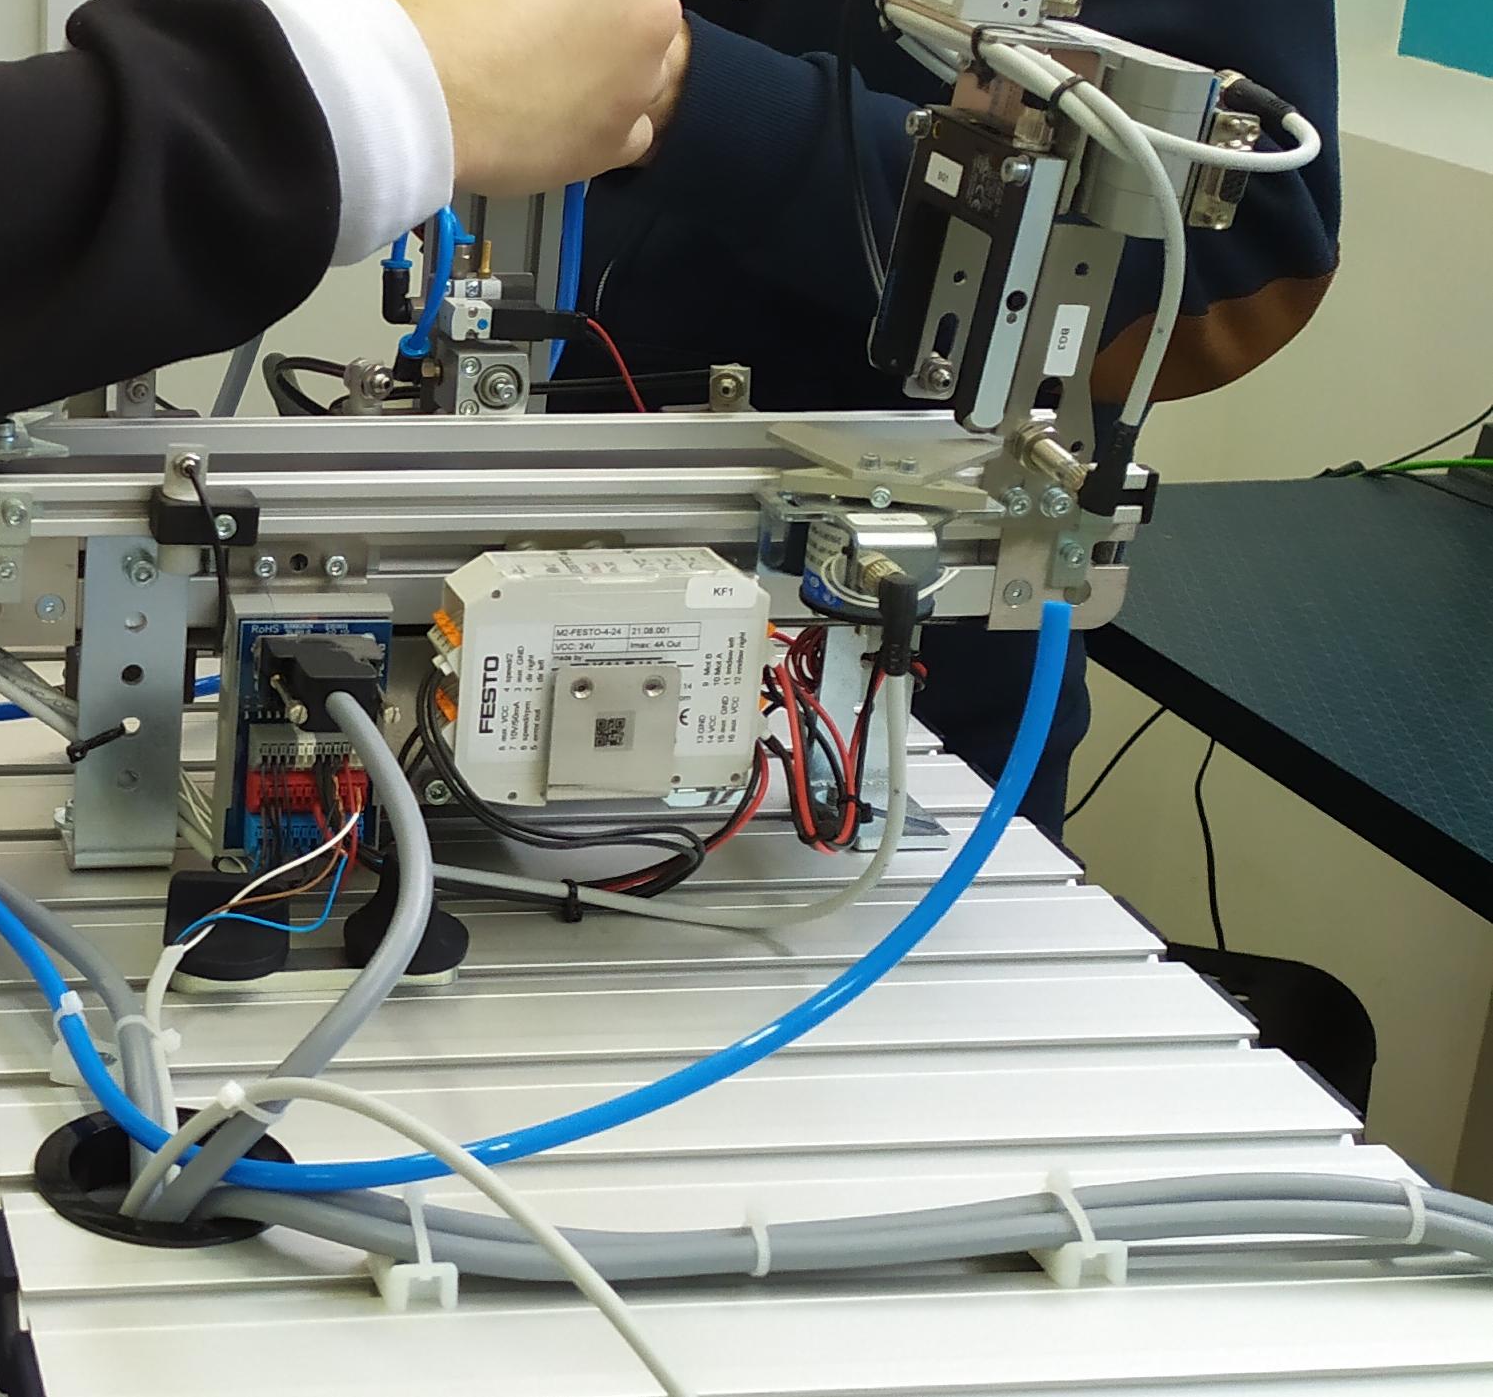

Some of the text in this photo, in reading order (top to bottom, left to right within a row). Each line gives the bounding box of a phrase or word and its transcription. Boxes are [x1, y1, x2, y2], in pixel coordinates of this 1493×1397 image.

[713, 587, 735, 597] KF1
[251, 624, 280, 634] RoHS
[556, 628, 622, 636] M2-FESTO-4-24
[479, 656, 499, 734] FESTO
[731, 696, 739, 714] VCC
